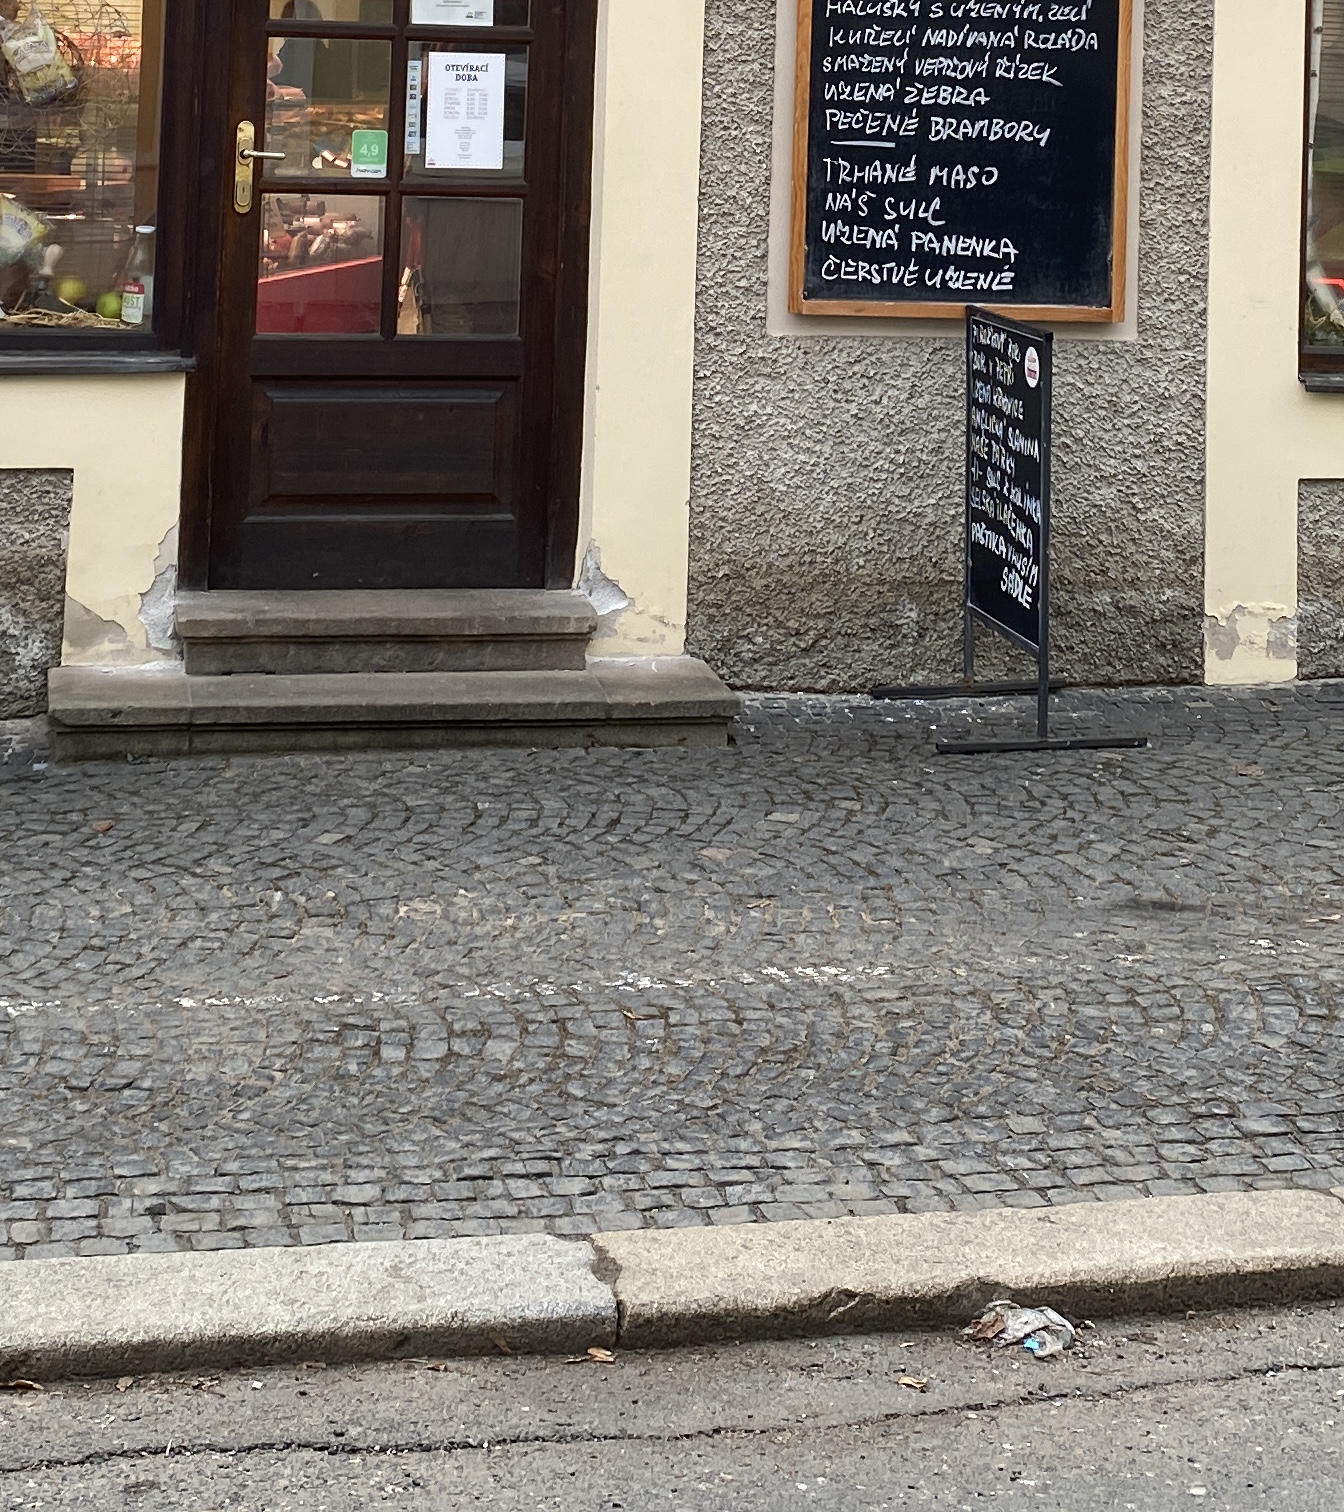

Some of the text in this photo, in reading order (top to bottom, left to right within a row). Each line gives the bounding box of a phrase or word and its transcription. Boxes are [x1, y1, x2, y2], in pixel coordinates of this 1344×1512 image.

[929, 2, 944, 18] S
[829, 23, 1099, 50] KUŘECÍ NADÍVANÁ ROLÁDA
[445, 62, 489, 72] OTEVÍRACÍ
[455, 73, 478, 81] DOBA
[823, 48, 909, 74] SMAŽENÝ
[994, 53, 1064, 86] ŘÍZEK
[825, 76, 991, 106] UZENÁ ŽEBRA
[825, 107, 1052, 148] PEČENÉ BRAMBORY
[822, 154, 999, 188] TRHANÉ MASO
[825, 189, 946, 226] NÁŠ SULC
[821, 219, 1020, 263] UZENÁ PANENKA
[924, 265, 1016, 290] UZENÉ
